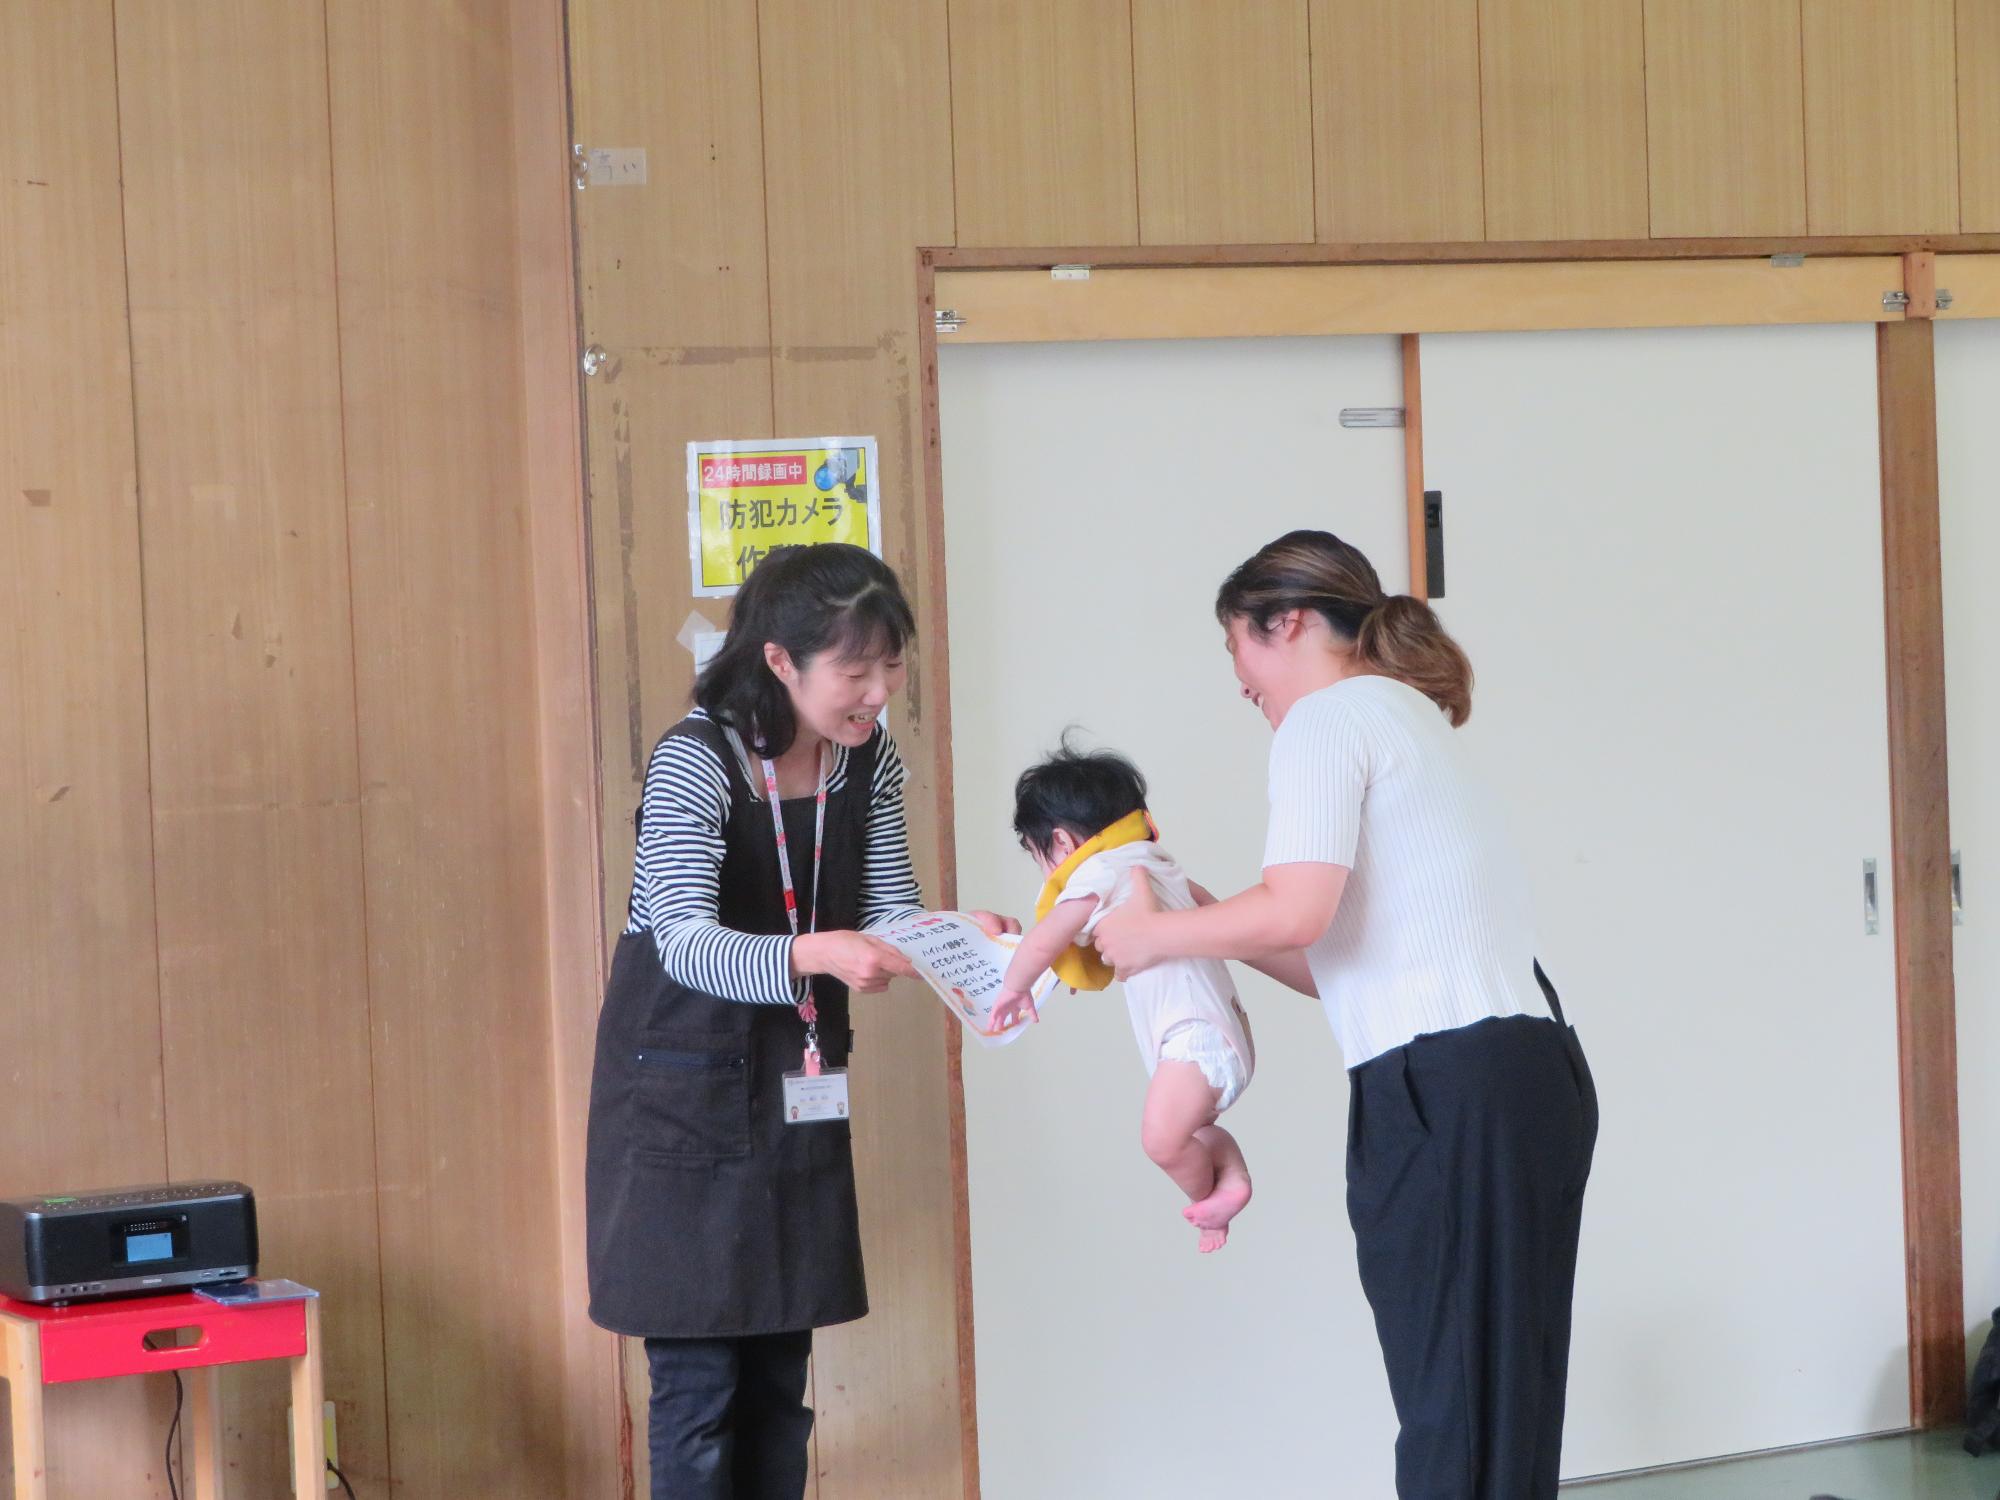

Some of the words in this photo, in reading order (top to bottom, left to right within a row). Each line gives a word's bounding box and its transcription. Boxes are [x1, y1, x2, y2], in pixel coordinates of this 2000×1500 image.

[704, 462, 802, 482] 24時間録画中
[720, 498, 843, 531] 防犯カメラ
